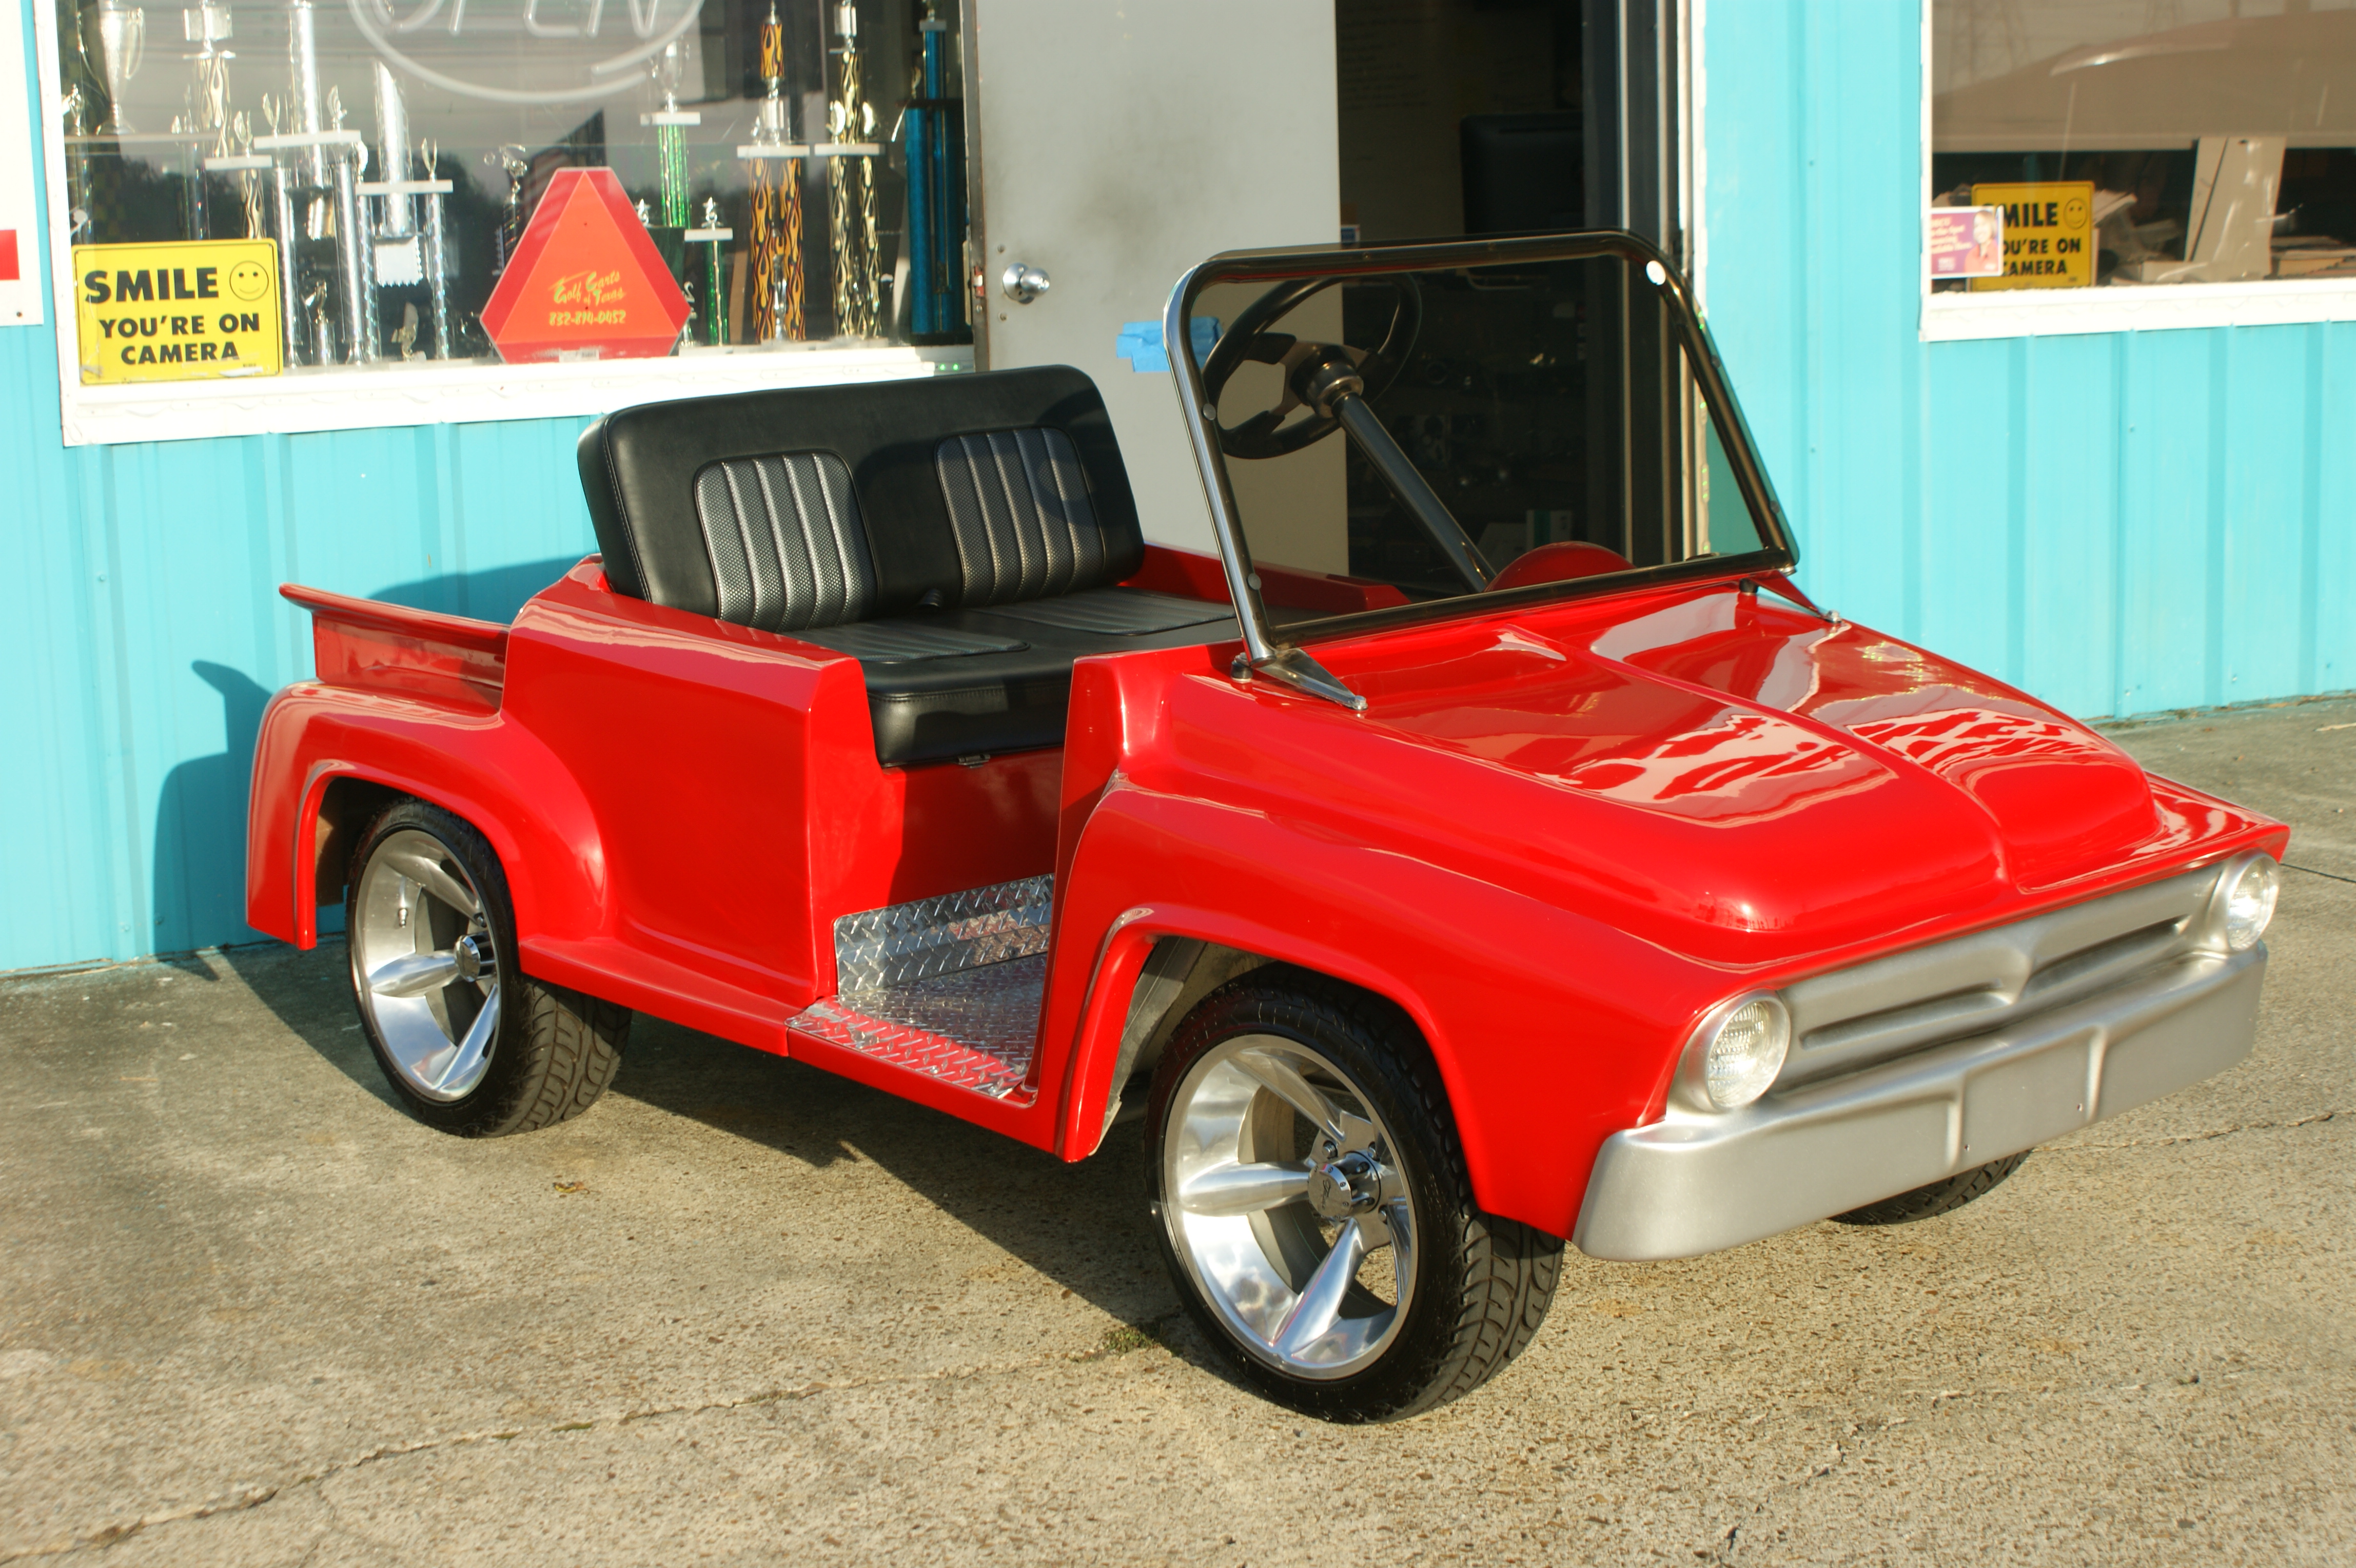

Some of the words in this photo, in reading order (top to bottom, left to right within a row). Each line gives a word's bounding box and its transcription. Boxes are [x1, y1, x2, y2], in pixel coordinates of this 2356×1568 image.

[1984, 202, 2058, 228] MILE
[2057, 238, 2081, 253] ON
[85, 267, 219, 304] SMILE
[99, 315, 205, 339] YOU'RE
[219, 312, 260, 333] ON
[121, 341, 240, 365] CAMERA
